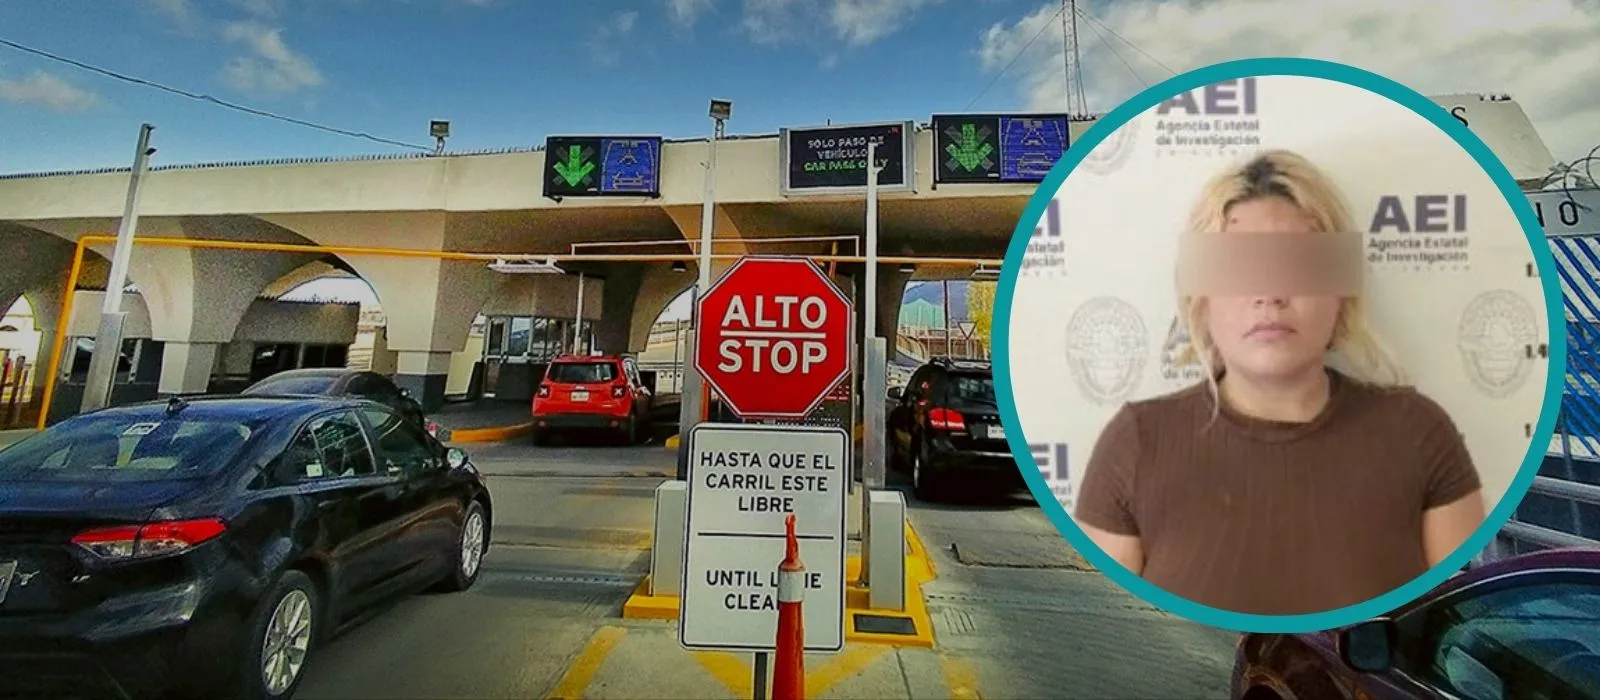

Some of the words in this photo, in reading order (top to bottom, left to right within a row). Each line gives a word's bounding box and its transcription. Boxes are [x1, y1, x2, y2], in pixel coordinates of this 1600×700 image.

[1156, 120, 1210, 134] Agencia
[1213, 120, 1260, 131] Estatal
[838, 136, 866, 148] PASO
[1156, 136, 1172, 146] de
[817, 148, 869, 160] VEHÍCULO
[804, 161, 827, 172] CAR
[1369, 194, 1468, 233] AEI
[1368, 238, 1421, 252] Agencia
[1423, 237, 1468, 249] Estatal
[1367, 252, 1384, 262] de
[720, 294, 828, 330] ALTO
[718, 339, 828, 374] STOP
[700, 451, 762, 468] HASTA
[768, 452, 806, 470] QUE
[813, 454, 835, 470] EL
[706, 473, 775, 490] CARRIL
[781, 475, 828, 492] ESTE
[738, 496, 794, 513] LIBRE
[706, 570, 763, 588] UNTIL
[770, 571, 822, 589] LE
[724, 593, 781, 611] CLEA
